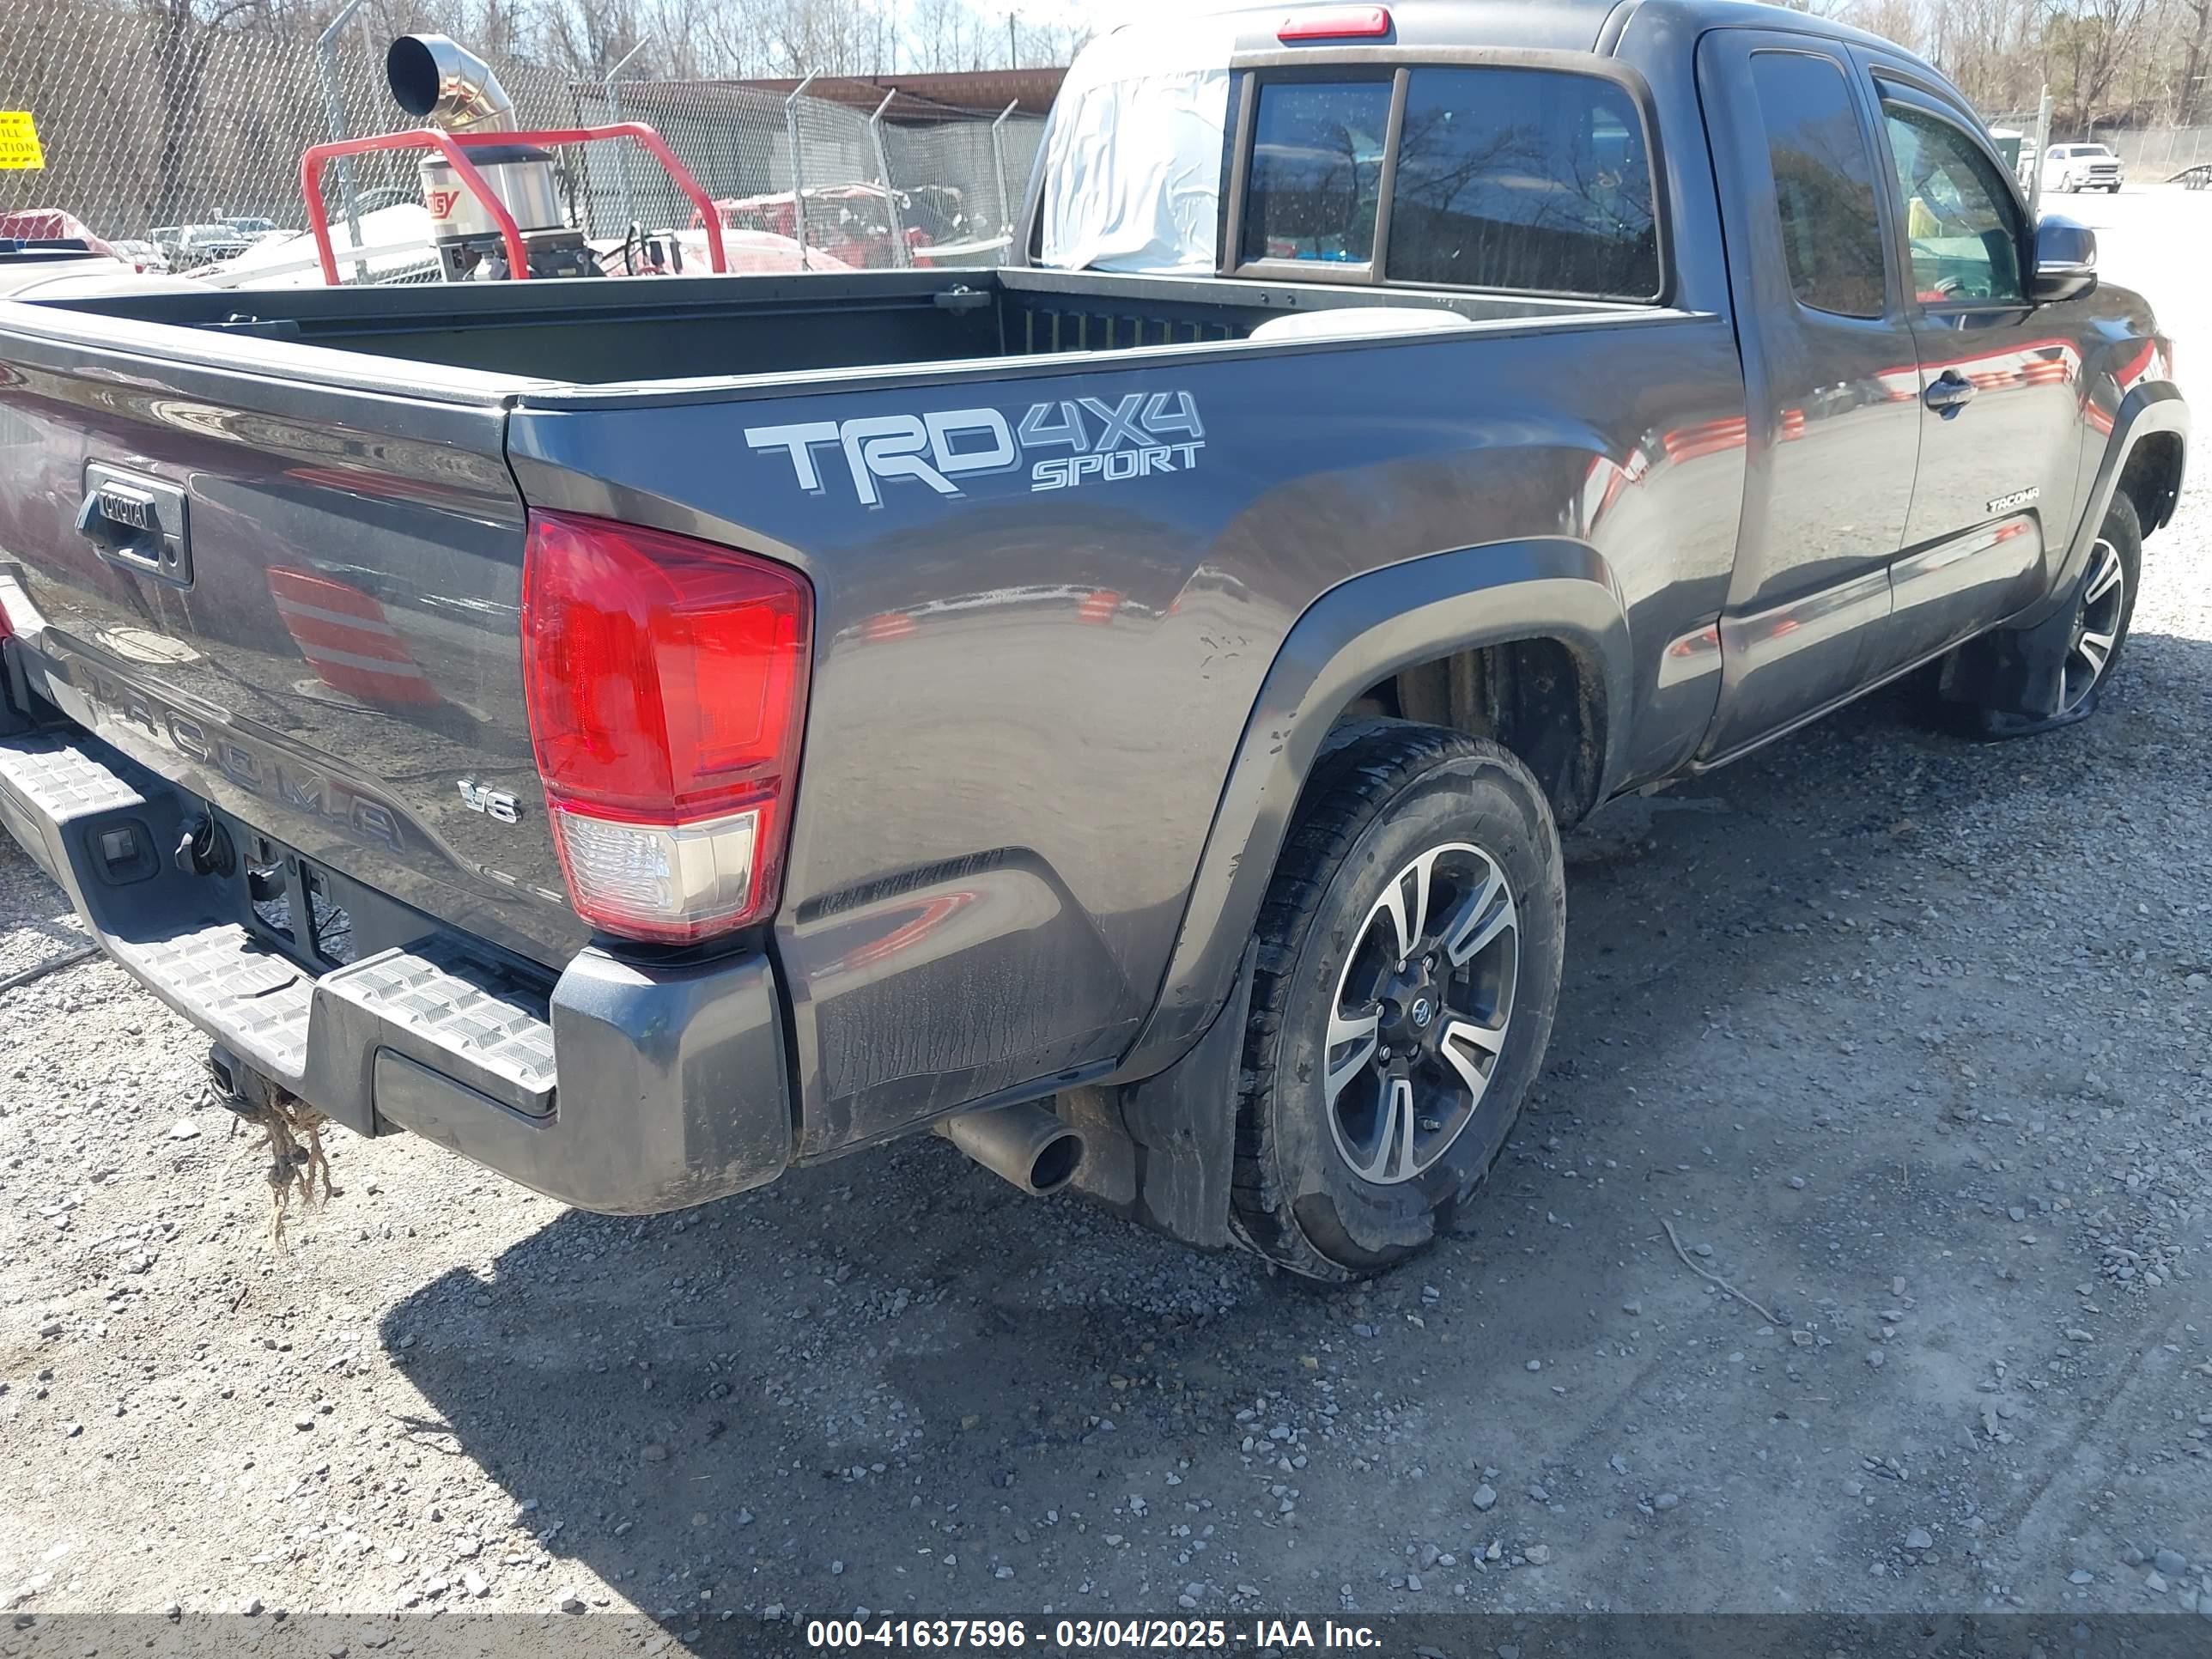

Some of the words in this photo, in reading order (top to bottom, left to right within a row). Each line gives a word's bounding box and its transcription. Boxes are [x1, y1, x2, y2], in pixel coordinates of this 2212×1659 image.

[744, 407, 1024, 511] TRD
[1030, 441, 1206, 492] SPORT
[98, 490, 146, 531] TOYOTA
[1986, 486, 2040, 514] TACOMA
[456, 779, 520, 824] V6
